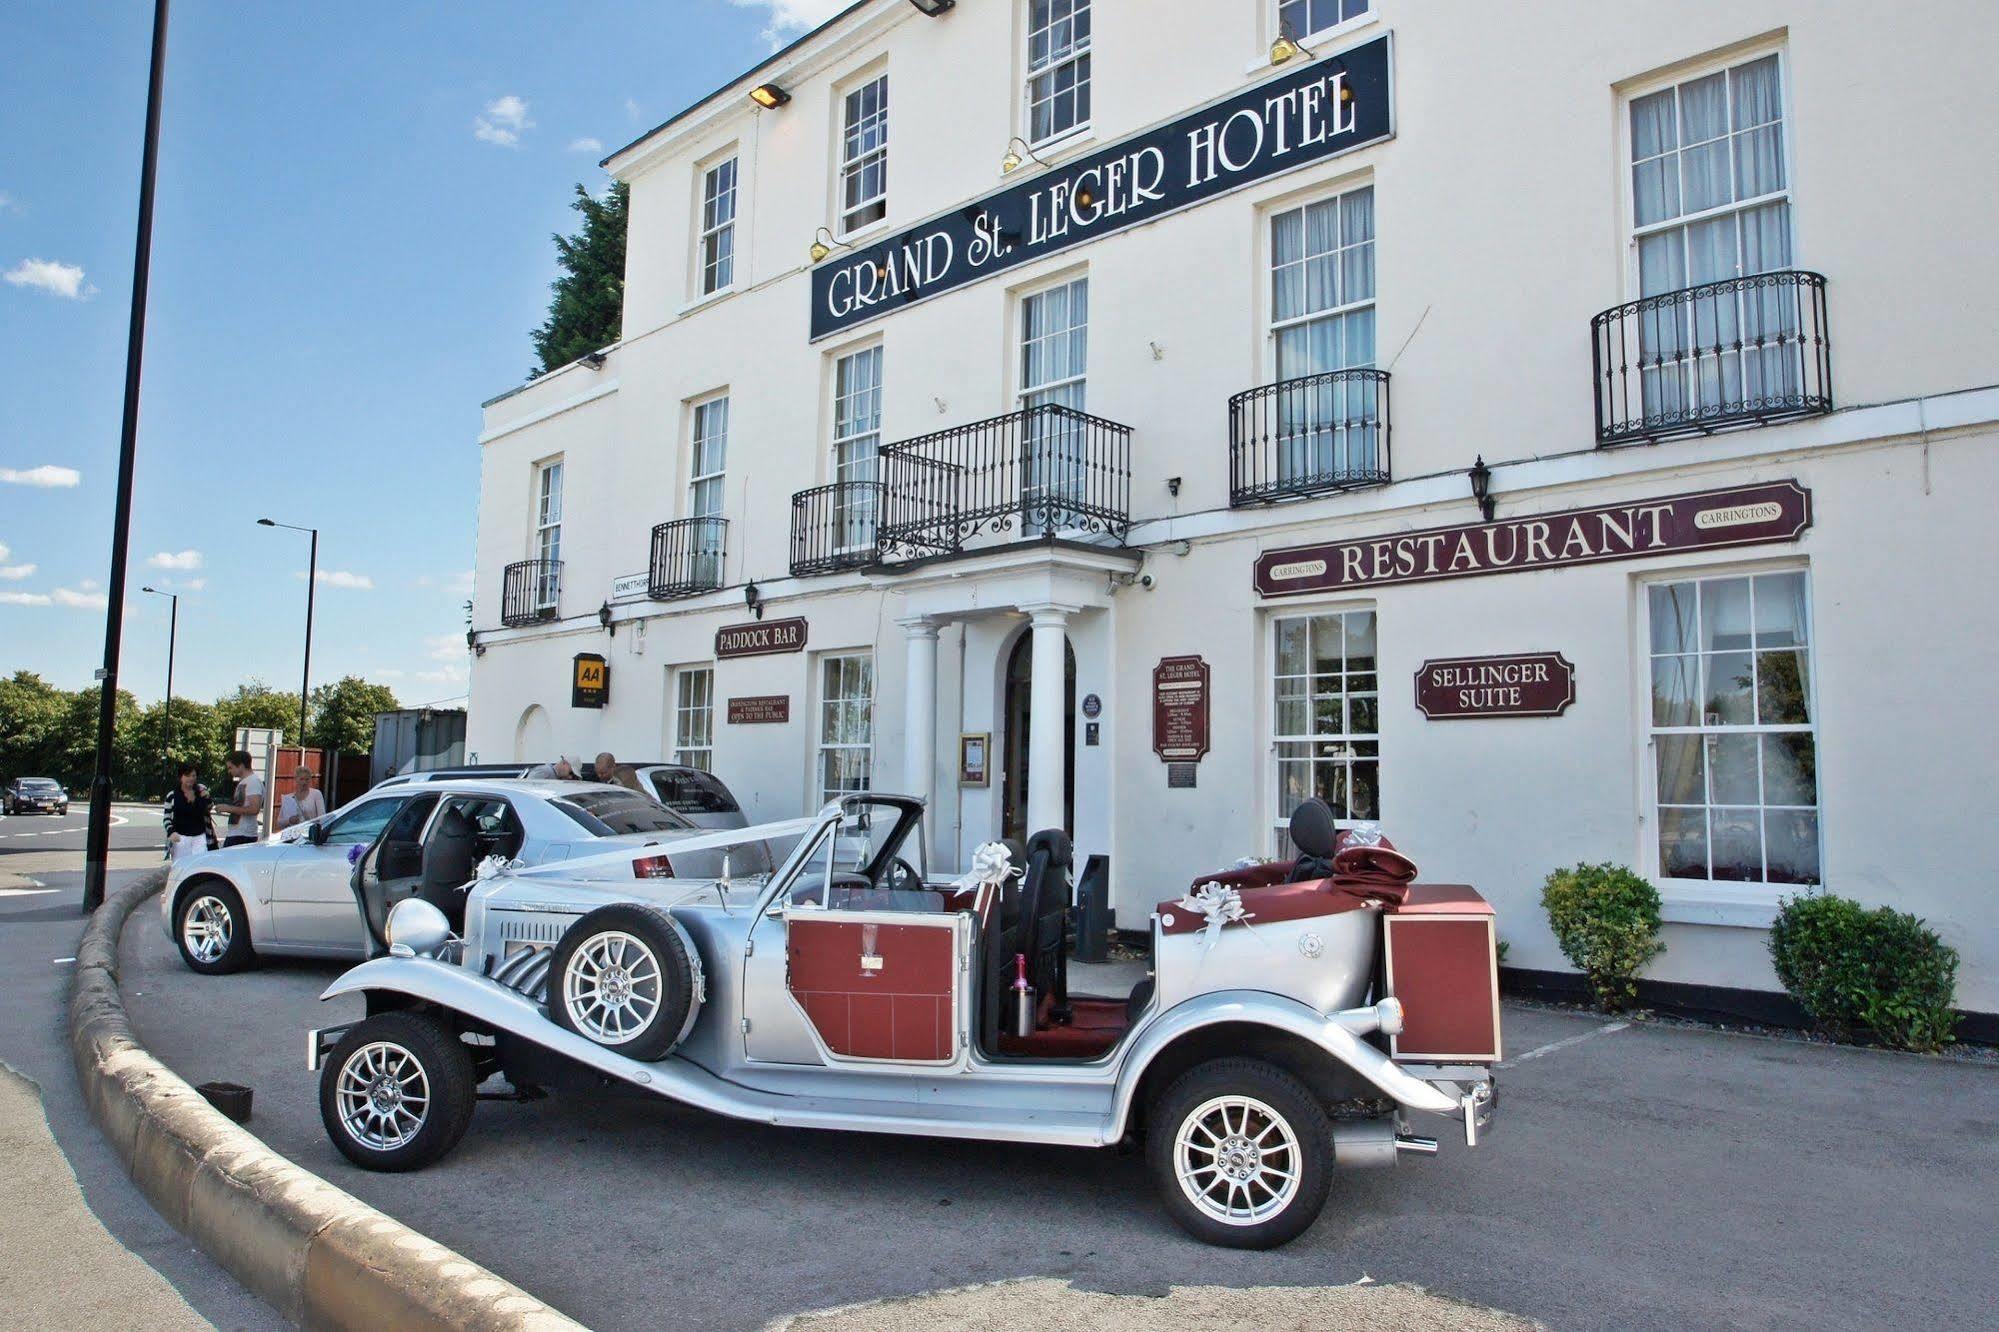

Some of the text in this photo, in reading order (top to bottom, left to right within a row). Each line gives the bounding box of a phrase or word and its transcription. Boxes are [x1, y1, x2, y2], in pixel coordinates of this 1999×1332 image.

[828, 71, 1356, 318] GRAND St. LEGER HOTEL
[1700, 504, 1777, 525] CARRINGTONS
[1340, 504, 1674, 583] RESTAURANT
[1273, 562, 1323, 577] CARRINGTONS
[720, 626, 797, 650] PADDOCK BAR
[581, 667, 600, 682] AA
[1432, 663, 1550, 688] SELLINGER
[1459, 686, 1521, 708] SUITE
